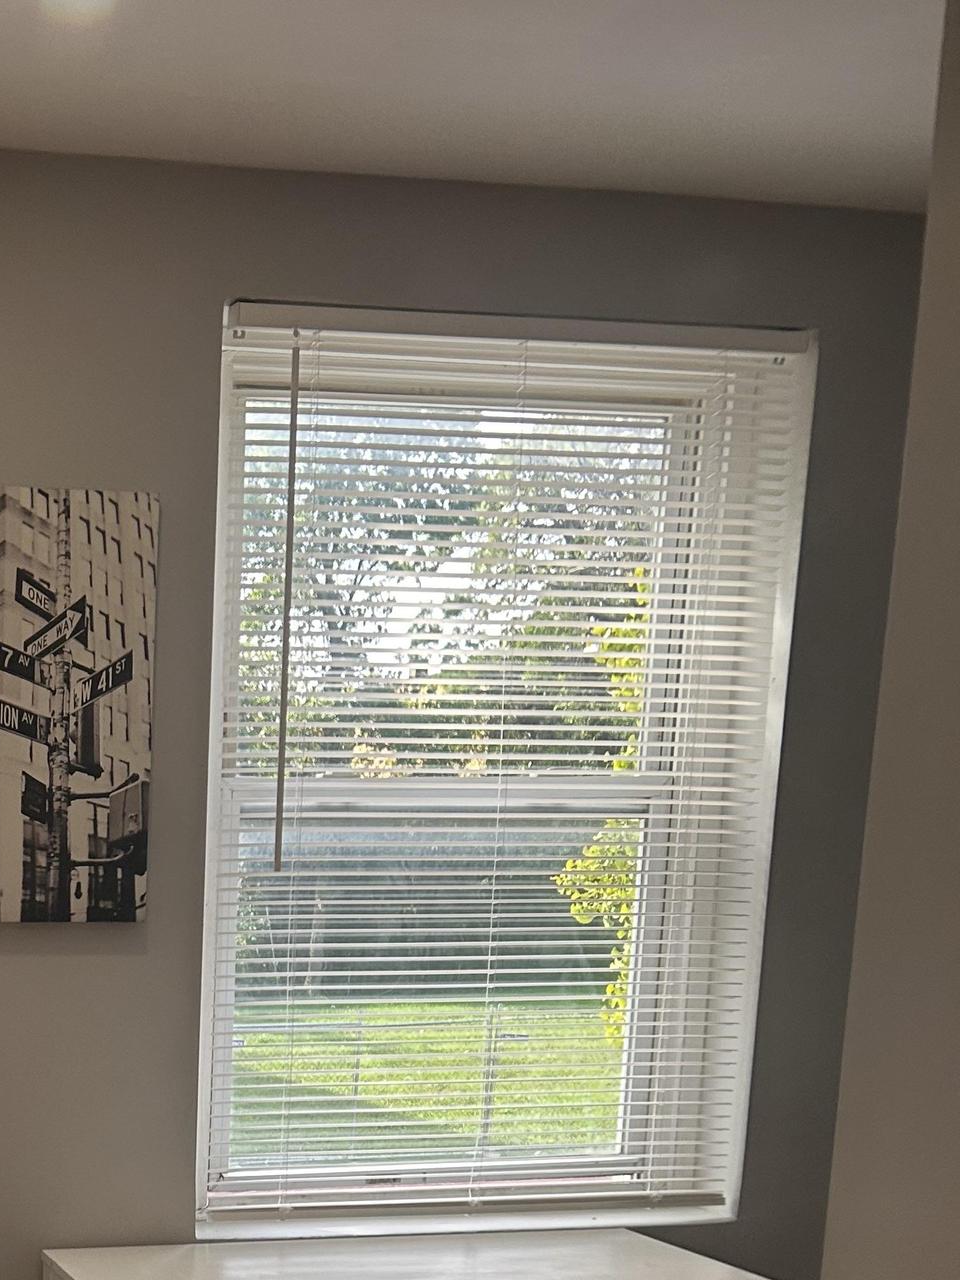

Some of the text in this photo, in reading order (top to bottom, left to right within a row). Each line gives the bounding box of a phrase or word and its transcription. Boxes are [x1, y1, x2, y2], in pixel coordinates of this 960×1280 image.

[28, 588, 49, 610] ONE
[56, 615, 74, 637] WAY
[1, 646, 30, 668] 7 AV
[81, 658, 127, 703] W 41 ST
[21, 713, 34, 725] AV
